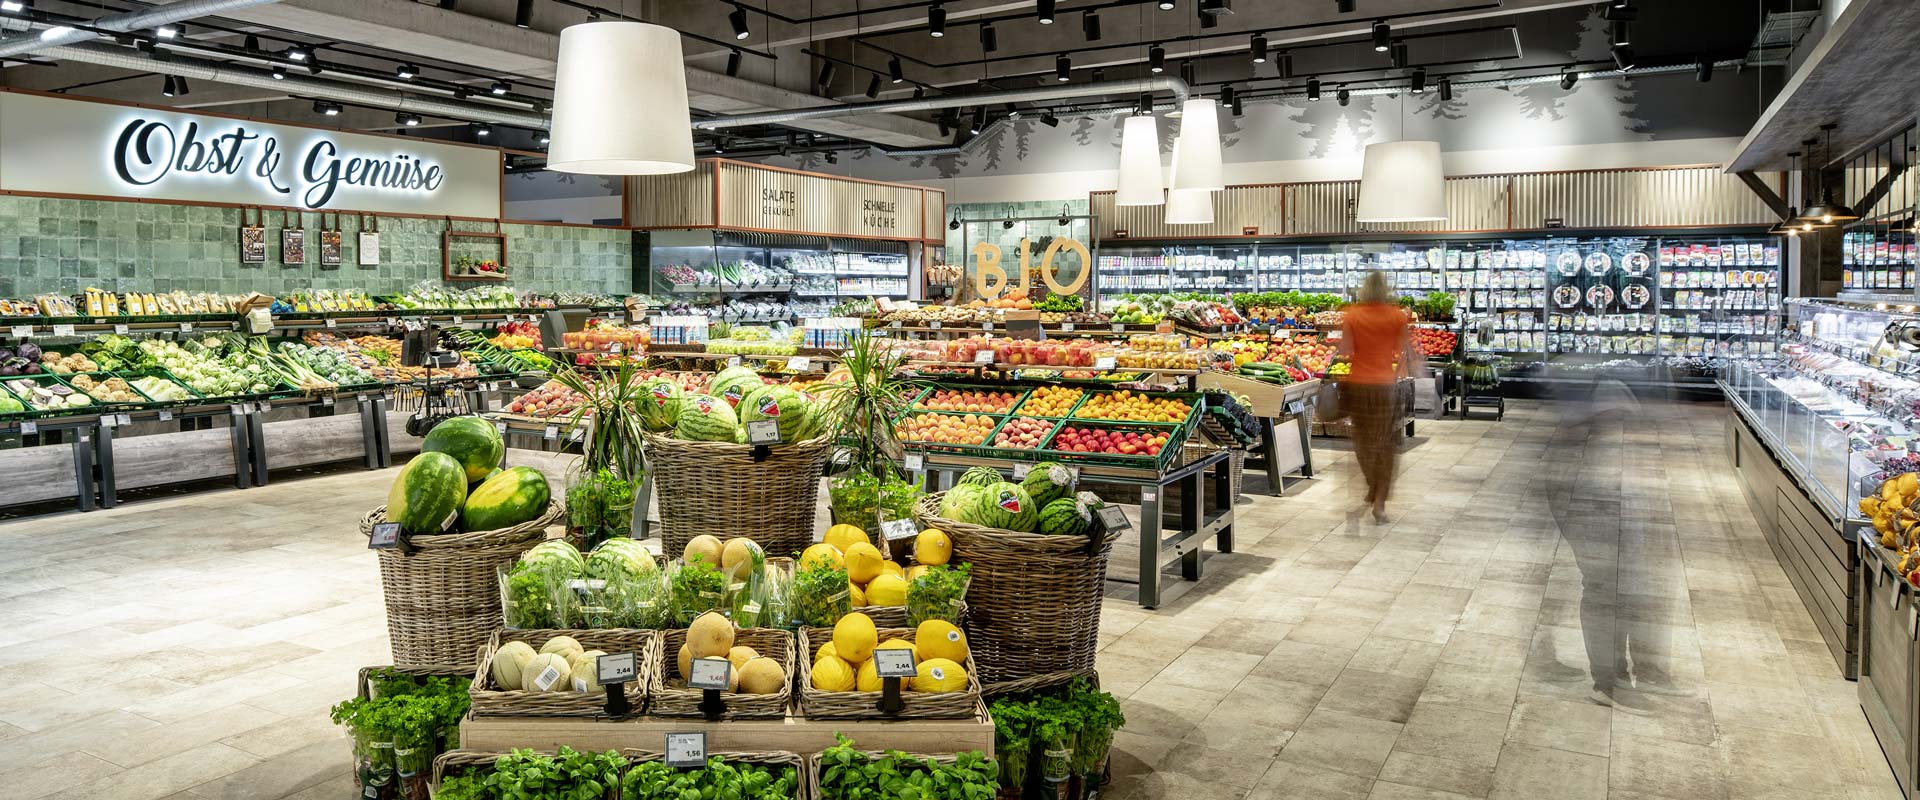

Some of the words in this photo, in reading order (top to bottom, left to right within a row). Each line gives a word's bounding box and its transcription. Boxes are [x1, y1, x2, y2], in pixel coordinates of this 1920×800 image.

[113, 119, 259, 185] Obst
[255, 137, 290, 194] &
[302, 139, 444, 209] Gemüse
[762, 188, 795, 204] SALATE
[762, 205, 795, 217] GEKÜHLT
[863, 199, 895, 213] SCHNELLE
[863, 214, 895, 229] KÜCHE
[616, 667, 631, 675] 2,44
[686, 750, 701, 758] 1,56
